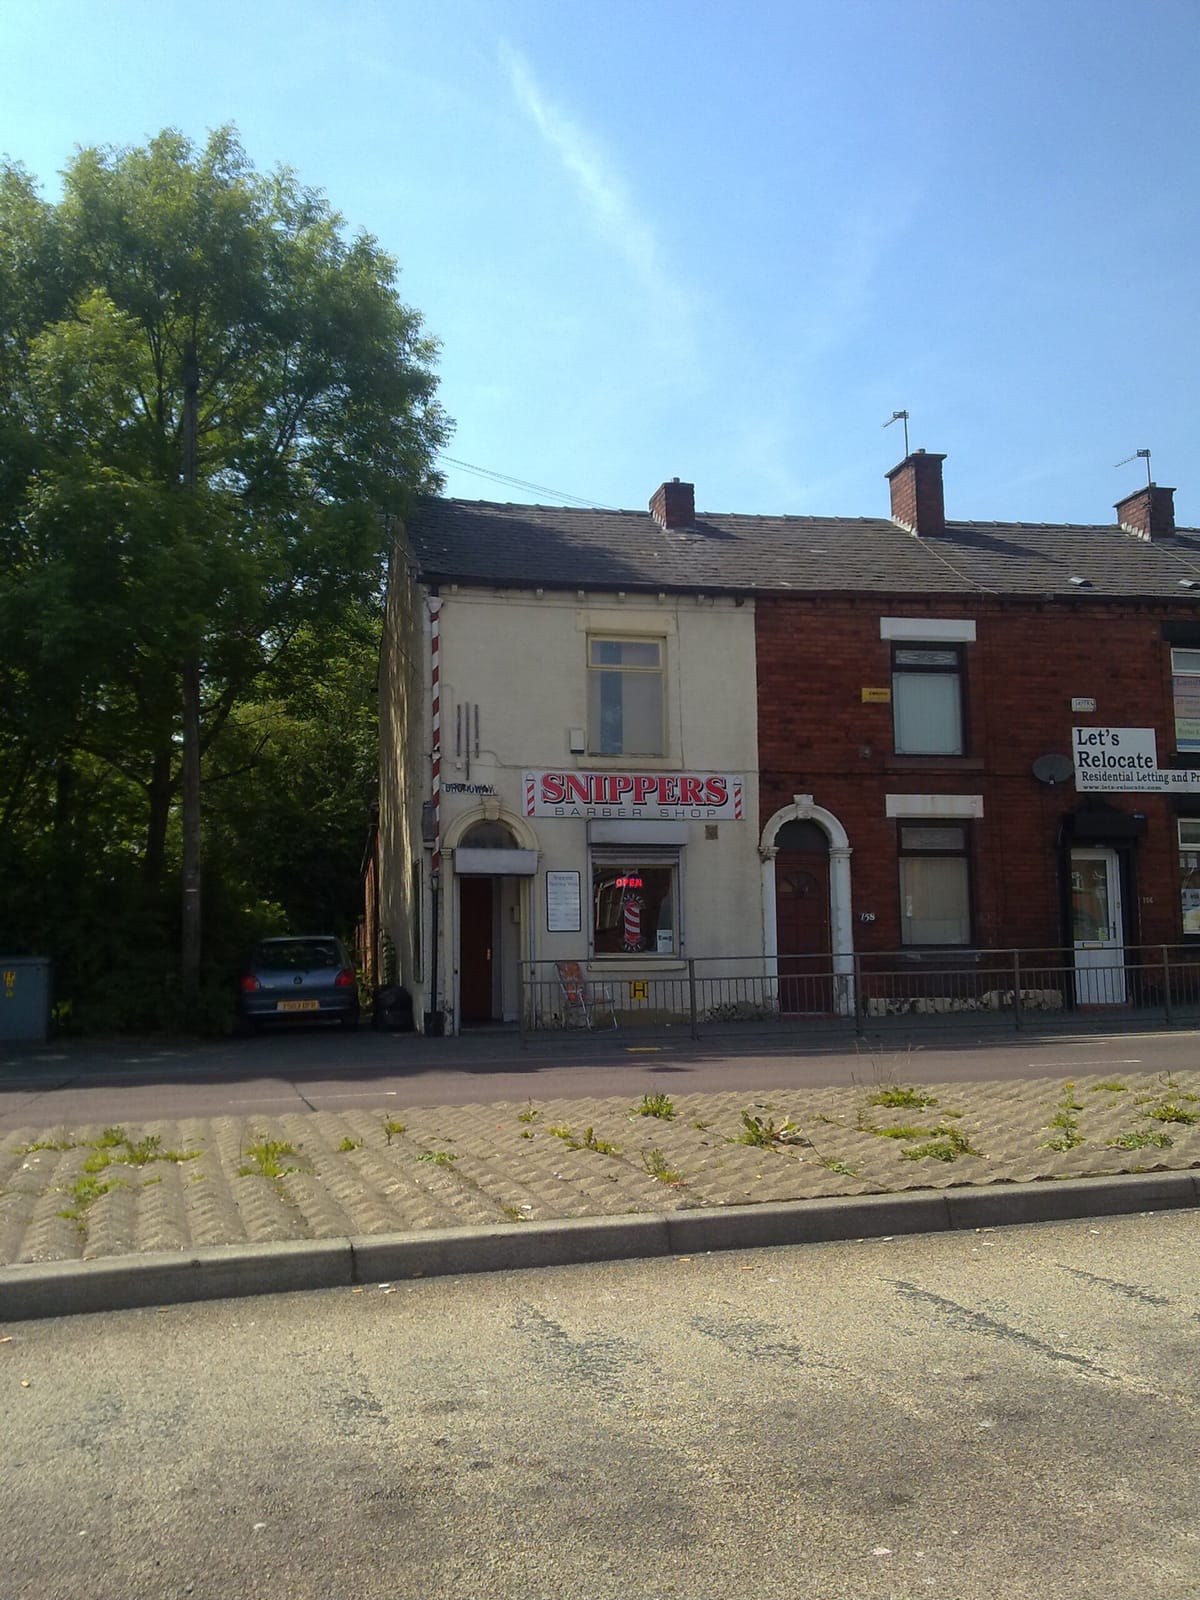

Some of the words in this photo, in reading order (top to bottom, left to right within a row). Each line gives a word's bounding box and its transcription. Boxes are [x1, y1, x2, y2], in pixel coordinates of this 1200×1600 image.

[1076, 728, 1120, 746] Let's
[1078, 751, 1154, 769] Relocate
[1081, 771, 1133, 782] Residential
[1136, 771, 1169, 785] Letting
[1171, 772, 1188, 782] and
[541, 773, 728, 807] SNIPPERS
[554, 807, 642, 817] BARBER
[659, 808, 717, 818] SHOP
[615, 878, 643, 888] OPEN
[860, 912, 876, 921] 158
[633, 982, 646, 998] H
